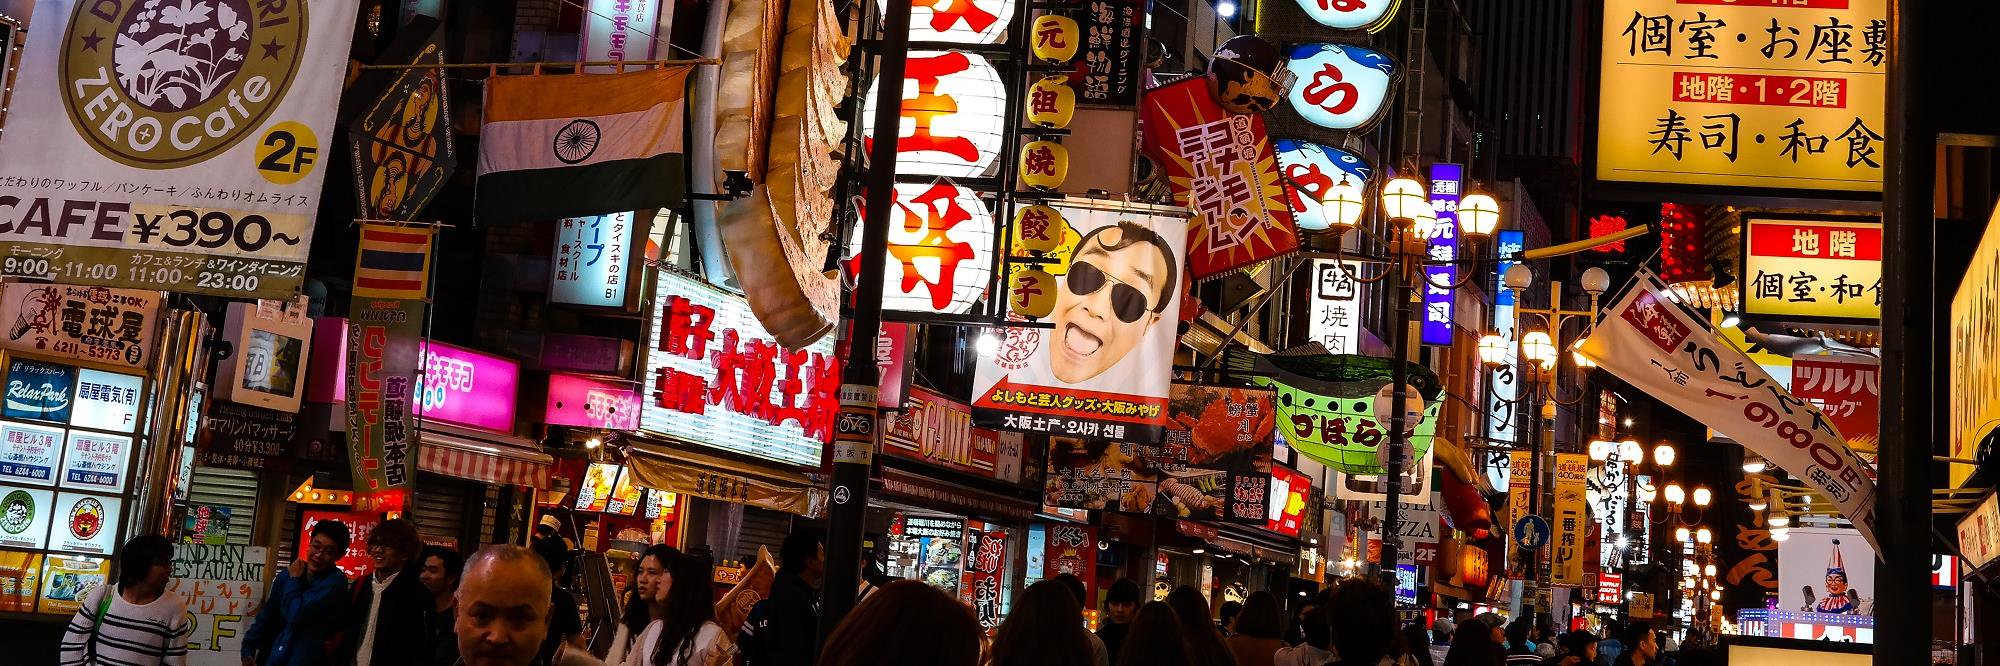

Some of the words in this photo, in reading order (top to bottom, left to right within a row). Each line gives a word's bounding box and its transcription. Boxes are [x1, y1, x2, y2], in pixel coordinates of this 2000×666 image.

[1679, 76, 1840, 106] 地階・1・2階
[75, 67, 162, 152] ZERO
[170, 75, 271, 152] Cafe
[258, 131, 317, 174] 2F
[1648, 109, 1884, 169] 寿司・和食
[1177, 125, 1238, 253] ミュージアム
[10, 245, 64, 261] モーニング
[1792, 228, 1857, 258] 地階
[605, 288, 617, 299] B1
[1323, 269, 1351, 293] 牛角
[61, 299, 144, 345] 電球屋
[1321, 305, 1348, 355] 焼肉
[1651, 359, 1689, 387] 1人前
[1796, 366, 1877, 396] ツルハ
[7, 380, 40, 401] Relax
[123, 413, 133, 425] F
[1290, 413, 1414, 447] づぼら
[1562, 510, 1577, 561] 一番搾り
[177, 543, 245, 564] INDIAN
[1416, 548, 1437, 562] 2F
